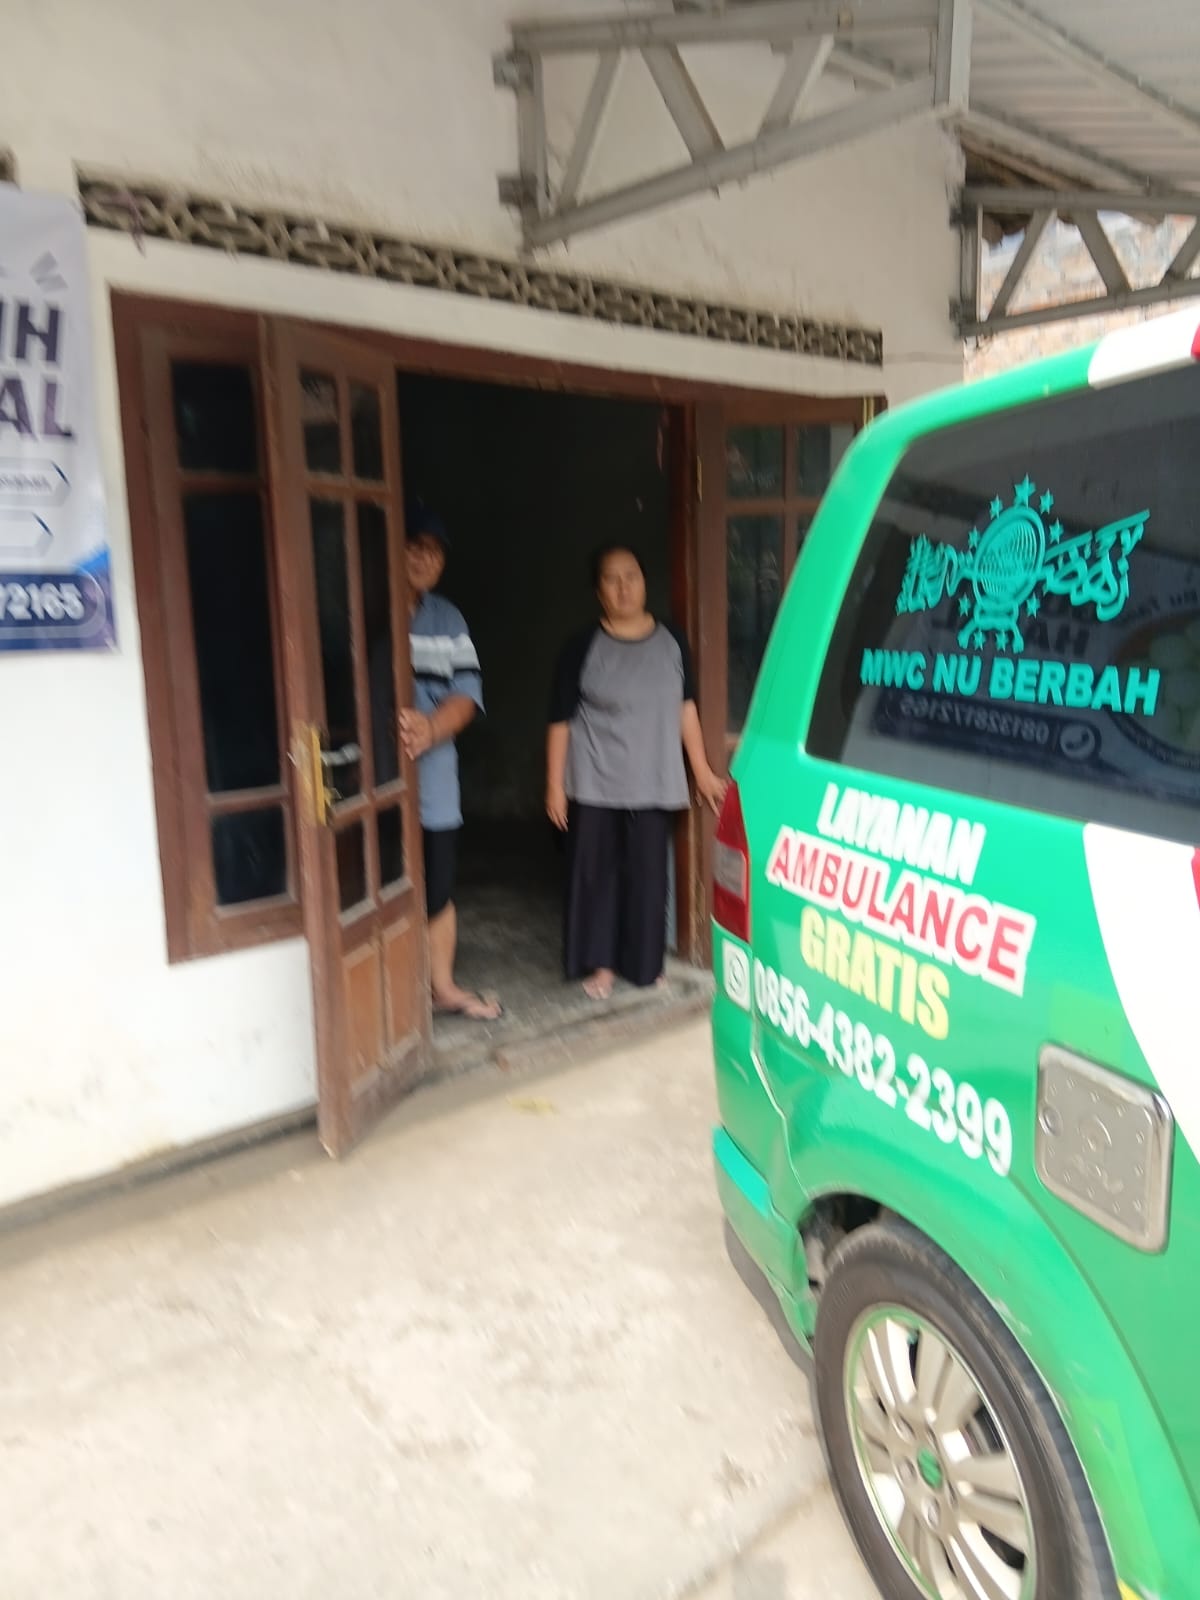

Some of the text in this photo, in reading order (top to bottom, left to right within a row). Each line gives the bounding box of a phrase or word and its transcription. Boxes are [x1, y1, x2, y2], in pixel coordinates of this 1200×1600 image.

[860, 648, 1160, 716] MWC NU BERBAH
[816, 782, 986, 885] LAYANAN
[767, 827, 1034, 994] AMBULANCE
[801, 905, 950, 1041] GRATIS
[754, 957, 1014, 1178] 0856-4382-2399
